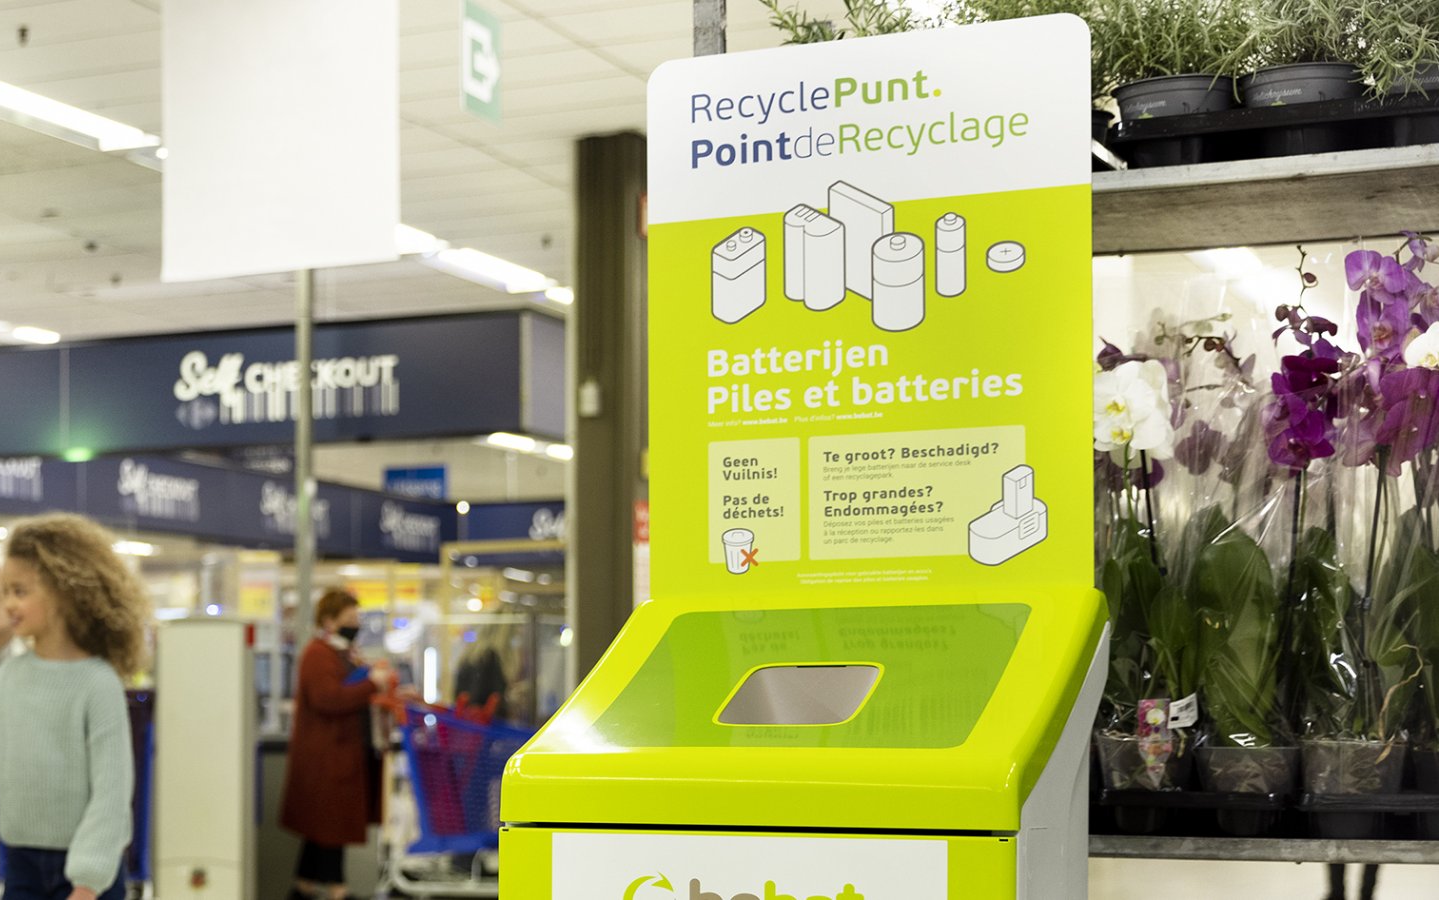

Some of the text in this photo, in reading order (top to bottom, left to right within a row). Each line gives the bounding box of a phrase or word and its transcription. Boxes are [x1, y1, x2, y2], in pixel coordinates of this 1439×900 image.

[691, 70, 942, 125] RecyclePunt.
[691, 111, 1029, 170] PointdeRecyclage
[707, 339, 889, 377] Batterijen
[173, 350, 400, 408] Self CHEKOUT
[707, 368, 1024, 415] Piles et batteries
[723, 456, 758, 468] Geen
[823, 442, 999, 465] Te groot? Beschadigd?
[722, 467, 778, 481] Vuilnis!
[723, 493, 770, 506] Pas de
[824, 486, 933, 503] Trop grandes?
[723, 506, 784, 519] déchets!
[824, 501, 943, 517] Endommagées?
